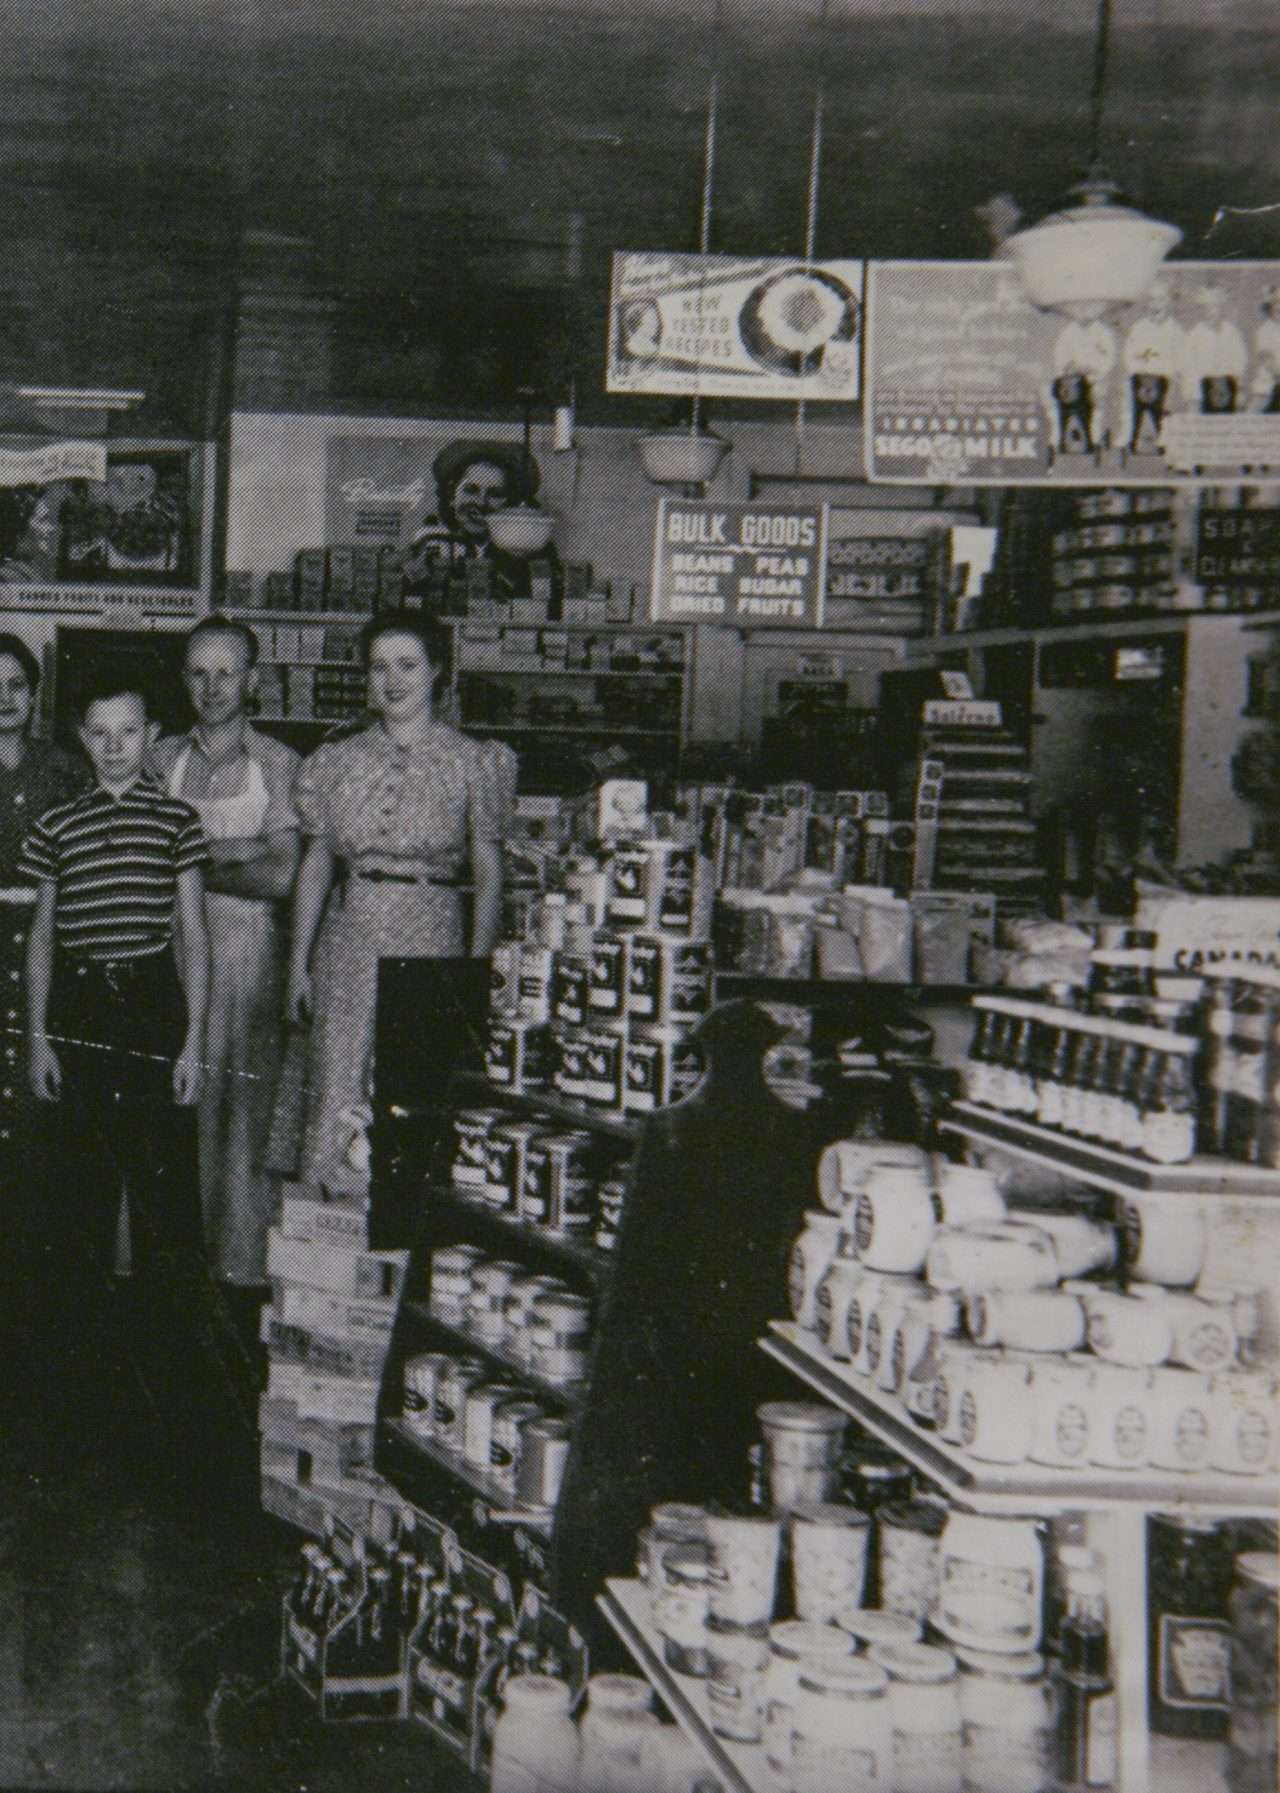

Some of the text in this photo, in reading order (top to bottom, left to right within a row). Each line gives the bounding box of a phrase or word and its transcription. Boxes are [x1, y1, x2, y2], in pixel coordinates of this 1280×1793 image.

[883, 417, 1039, 431] IRRADIATED
[876, 435, 1038, 458] SEGO MILK
[669, 512, 816, 547] BULK GOODS
[672, 554, 809, 576] BEANS PEAS
[674, 575, 803, 595] RICE SUGAR
[670, 595, 805, 617] DRIED FRUITS
